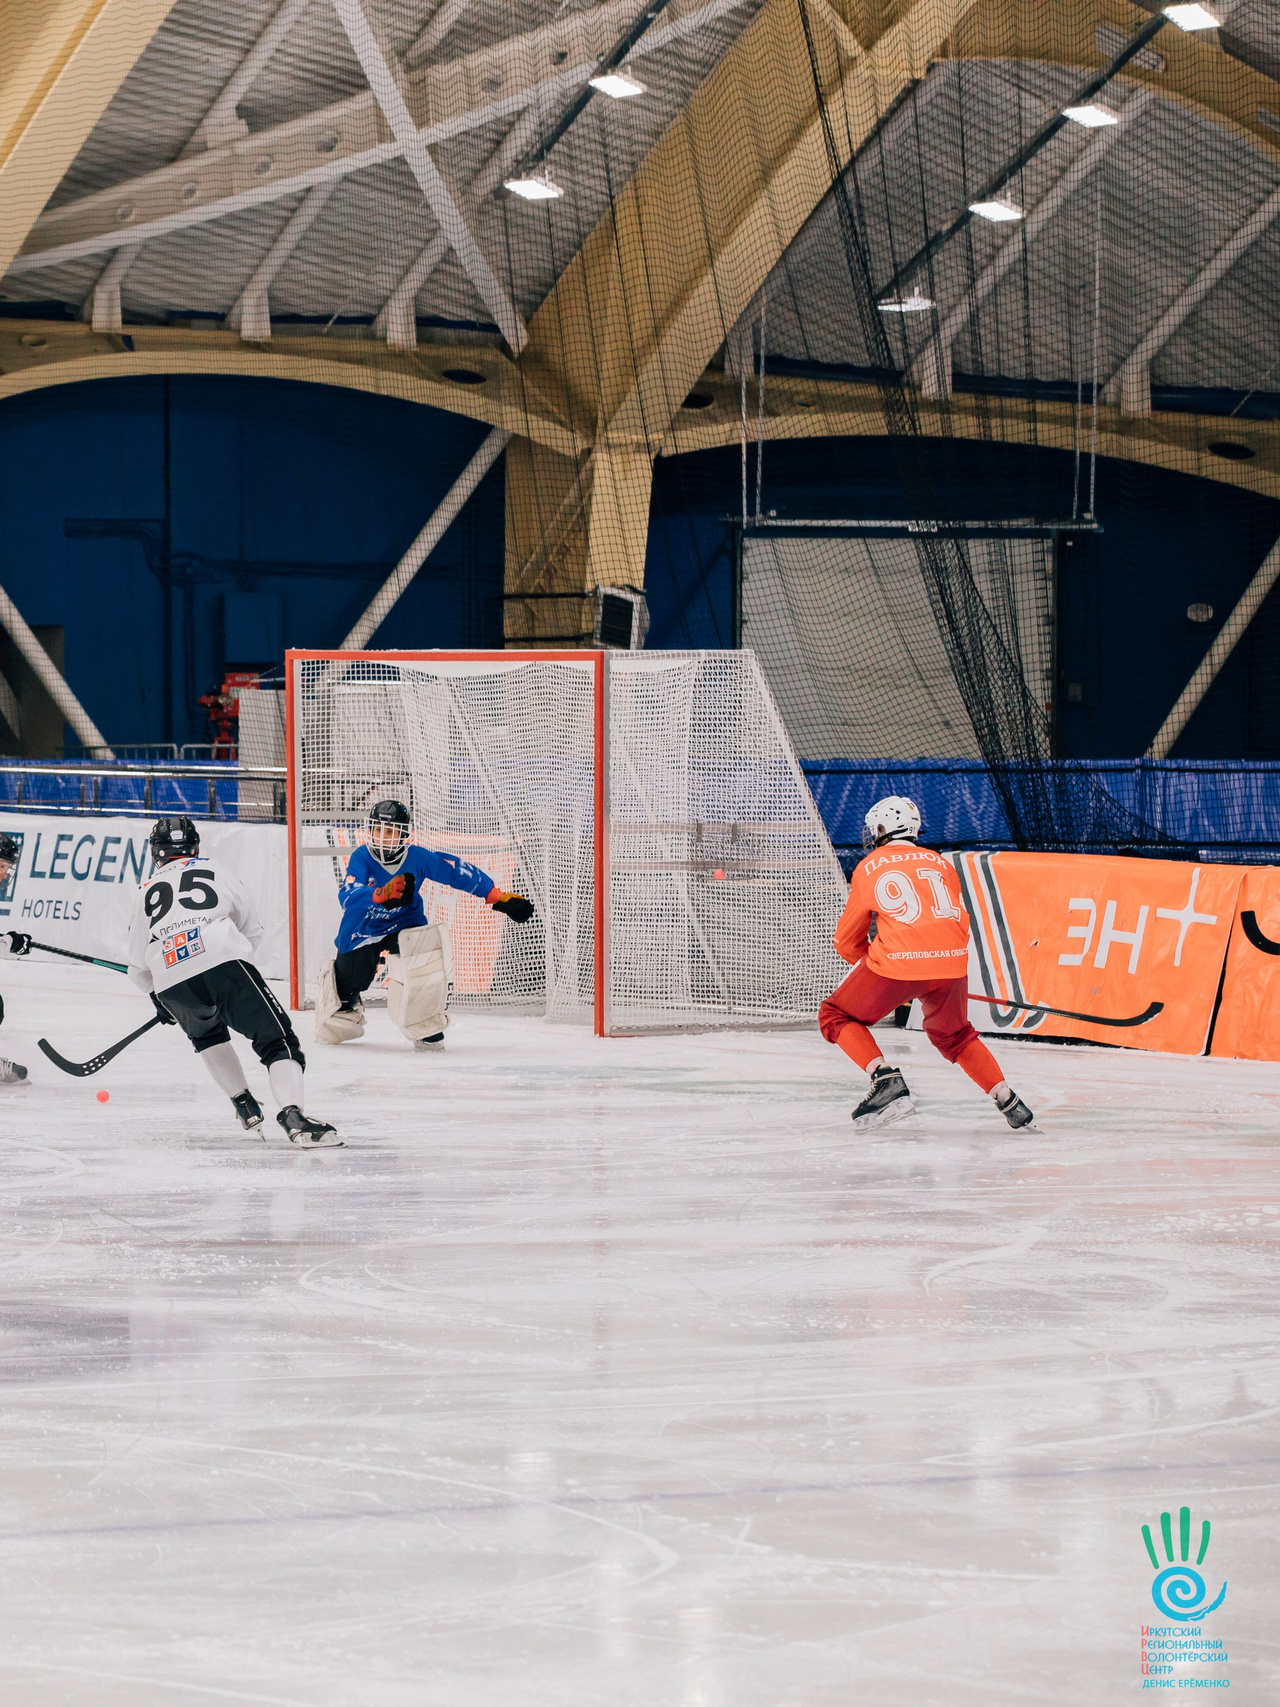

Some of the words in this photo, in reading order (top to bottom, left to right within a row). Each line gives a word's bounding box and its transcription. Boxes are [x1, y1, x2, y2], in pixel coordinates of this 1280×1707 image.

[30, 832, 157, 885] LEGEN
[864, 852, 947, 876] ПАВЛЮК
[21, 899, 82, 921] HOTELS
[144, 869, 219, 930] 95
[874, 867, 961, 925] 91
[886, 950, 950, 960] СВЕРДЛОВСКАЯ
